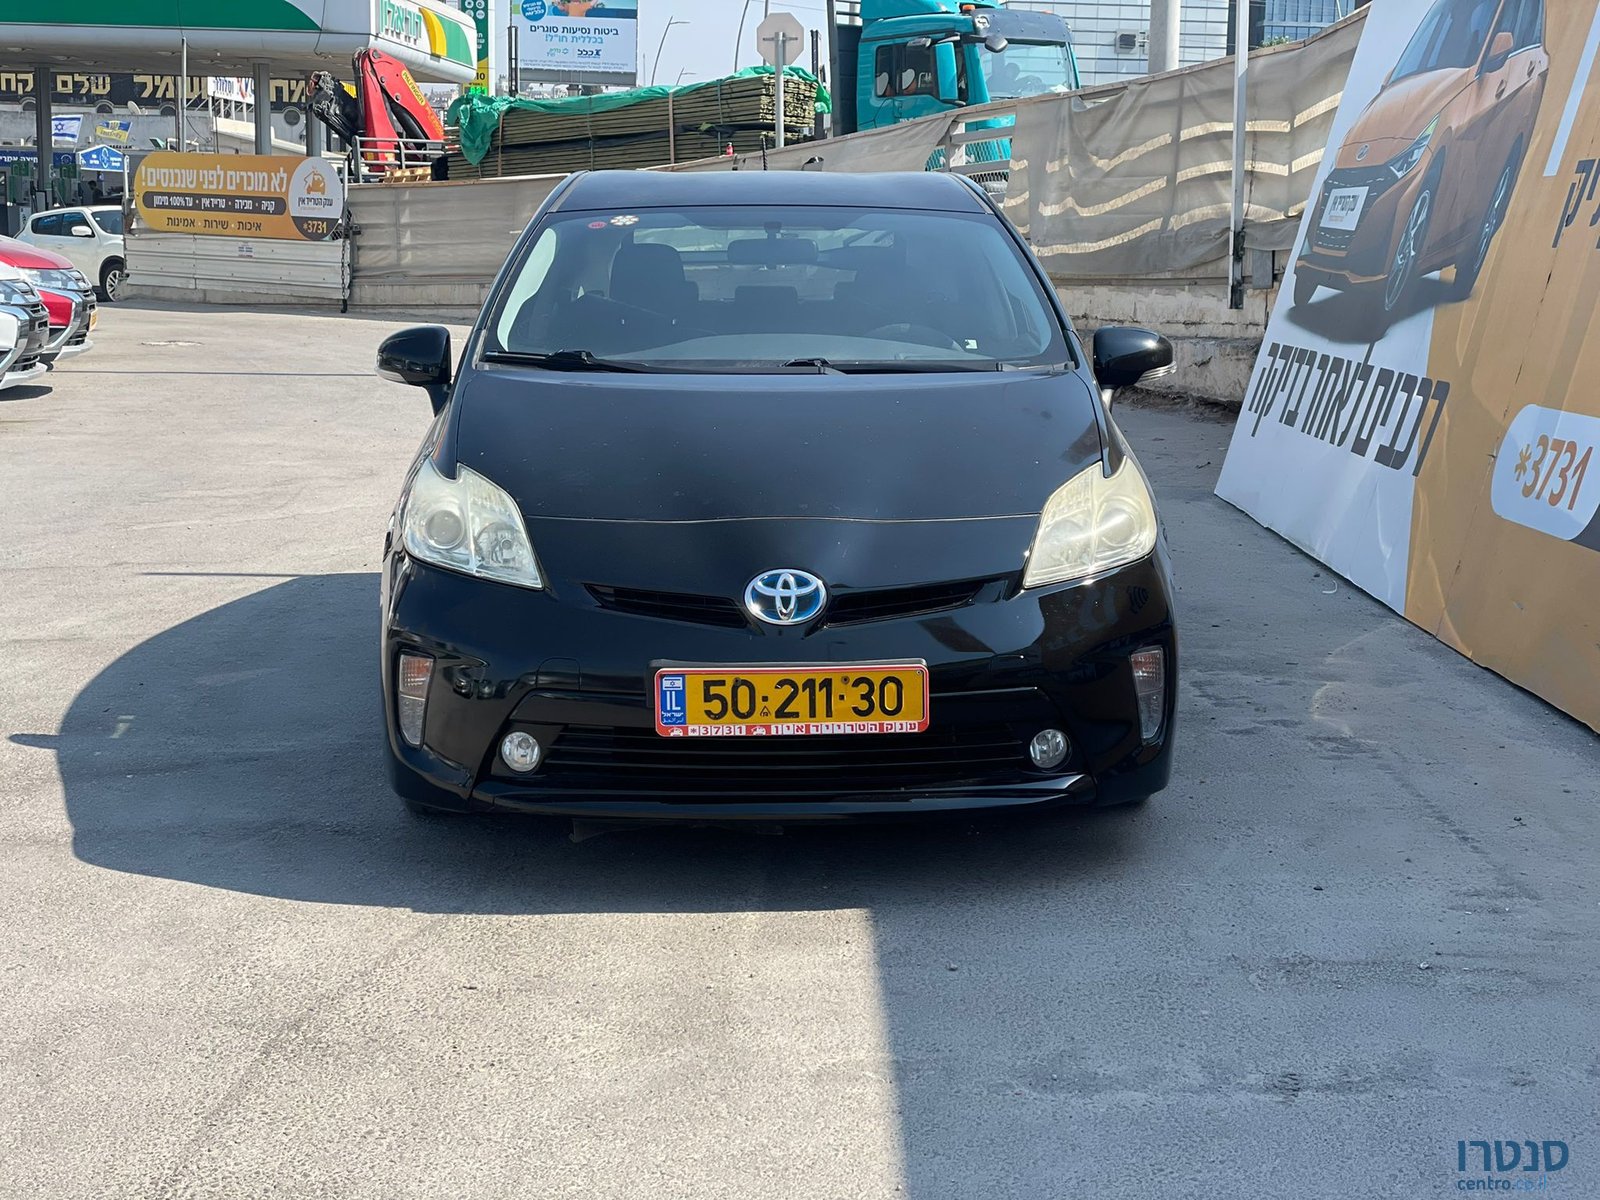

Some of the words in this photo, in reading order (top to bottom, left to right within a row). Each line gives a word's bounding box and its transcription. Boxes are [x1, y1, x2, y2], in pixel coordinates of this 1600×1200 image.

[561, 25, 591, 35] נסיעות
[593, 26, 619, 36] ביטוח
[571, 34, 604, 44] בכללית
[57, 73, 111, 95] שלם
[402, 71, 425, 105] PALFINGER
[141, 166, 197, 189] שנכנסים!
[200, 165, 224, 190] לפני
[227, 170, 268, 191] מוכרים
[270, 167, 287, 192] לא
[153, 195, 169, 207] מימון
[169, 196, 185, 206] 100%
[185, 197, 193, 207] עד
[234, 199, 253, 209] מכירה
[261, 200, 275, 213] קניה
[166, 216, 196, 228] אמינות
[203, 219, 229, 230] שירות
[237, 220, 262, 231] איכות
[1248, 343, 1318, 437] בדיקה
[1301, 341, 1375, 447] לאחר
[1351, 367, 1451, 477] רכבים
[666, 691, 680, 711] IL
[771, 724, 807, 735] אין
[810, 723, 879, 735] הטרייד
[882, 722, 919, 733] ענק
